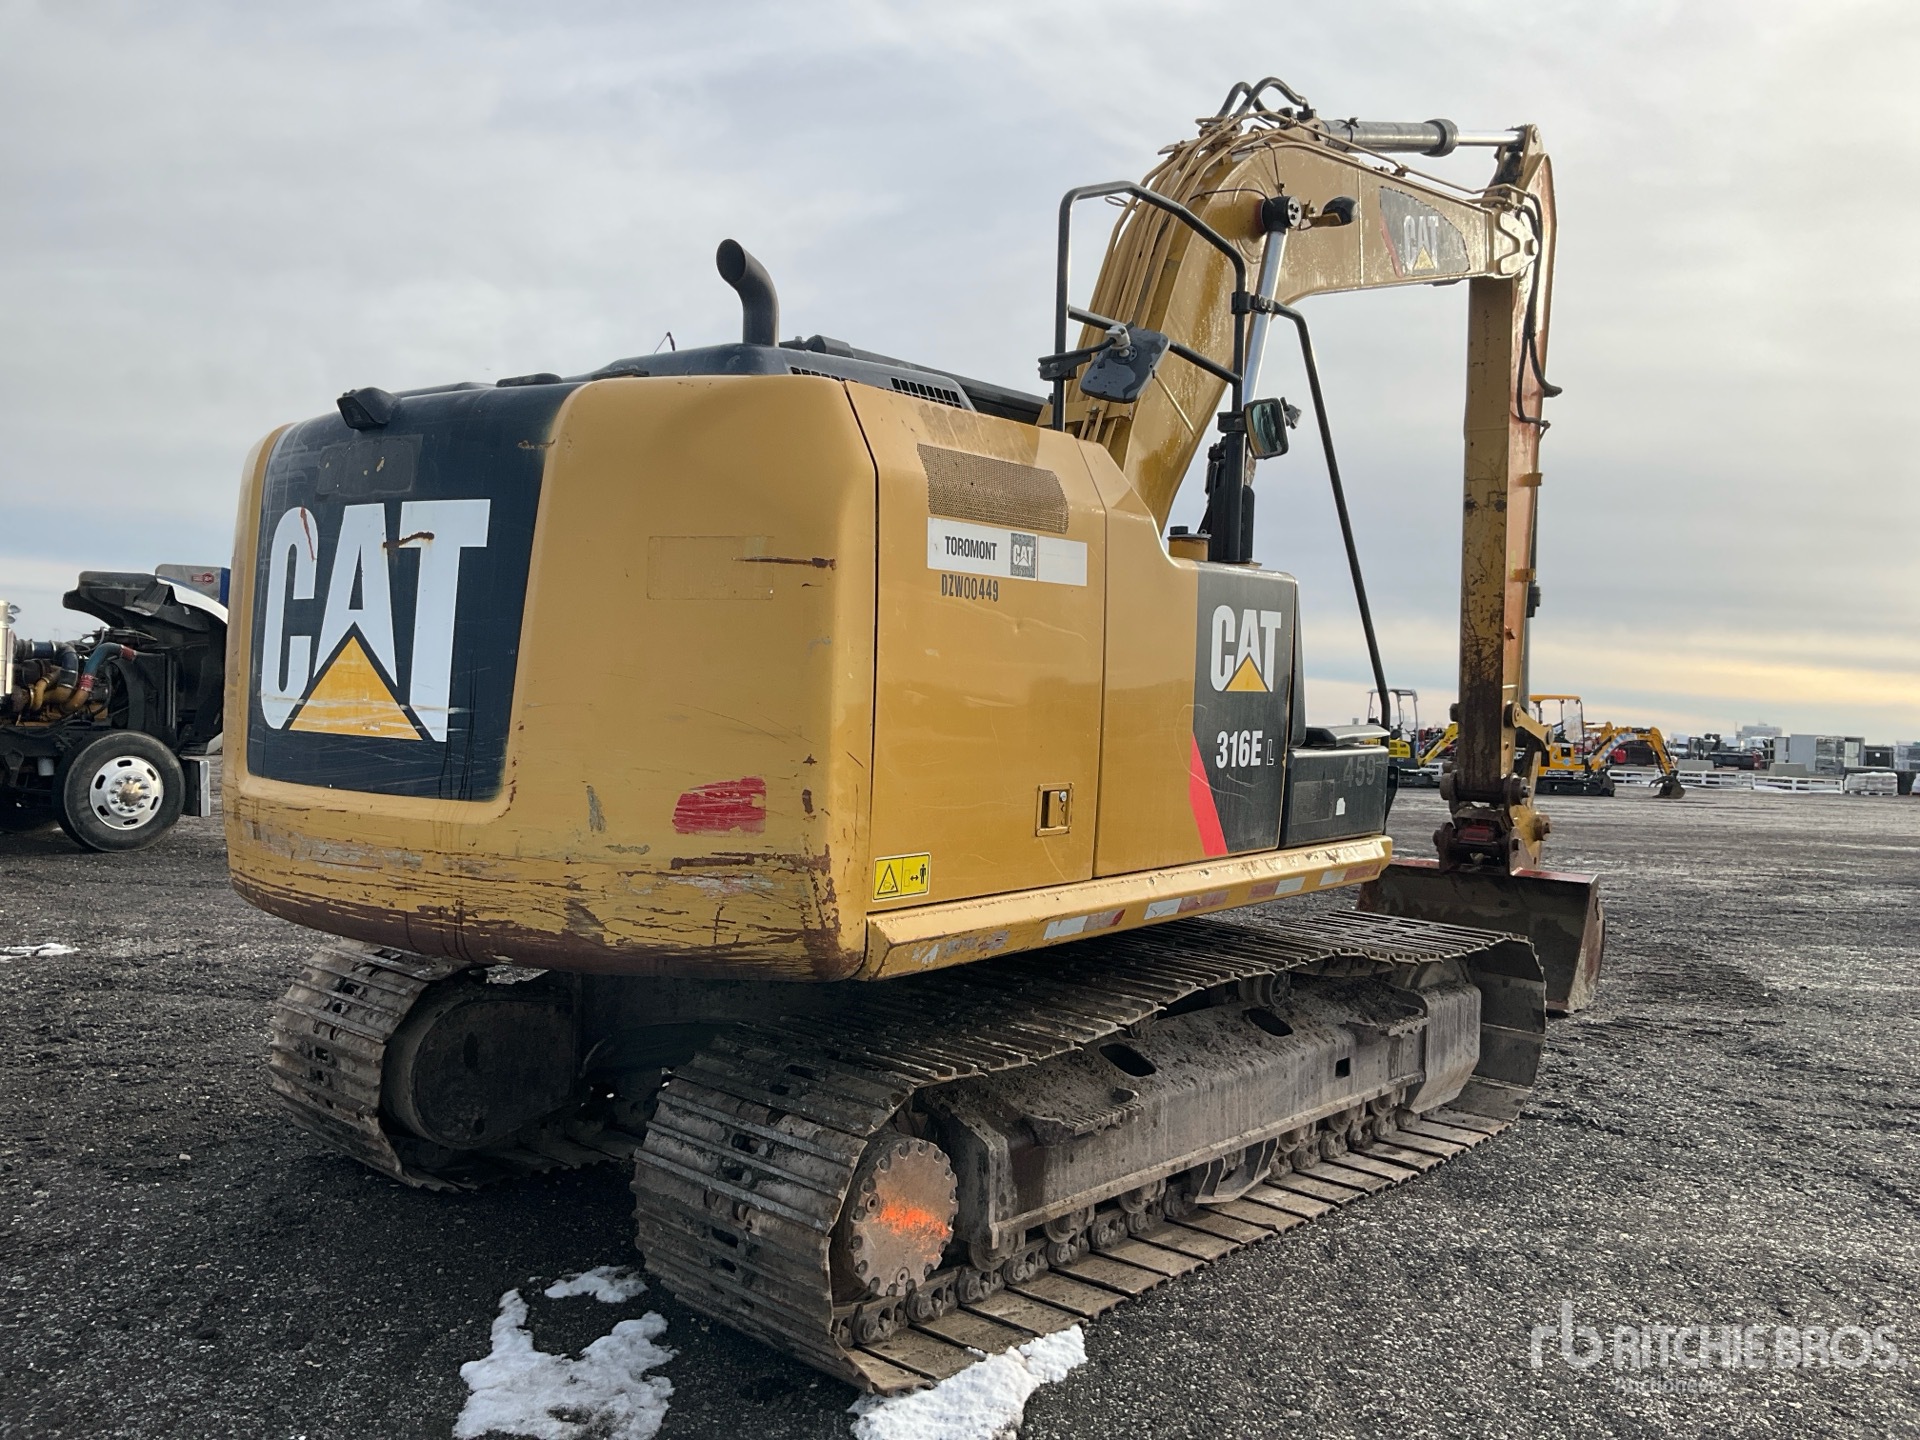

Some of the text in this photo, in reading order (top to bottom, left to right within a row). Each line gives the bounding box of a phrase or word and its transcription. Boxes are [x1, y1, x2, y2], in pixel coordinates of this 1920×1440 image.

[1404, 214, 1439, 273] CAT
[944, 535, 1034, 567] TOROMONT CAT
[941, 573, 999, 602] DZW00449
[260, 498, 491, 742] CAT
[1210, 604, 1282, 693] CAT
[1215, 729, 1275, 769] 316E L
[1343, 754, 1376, 787] 459
